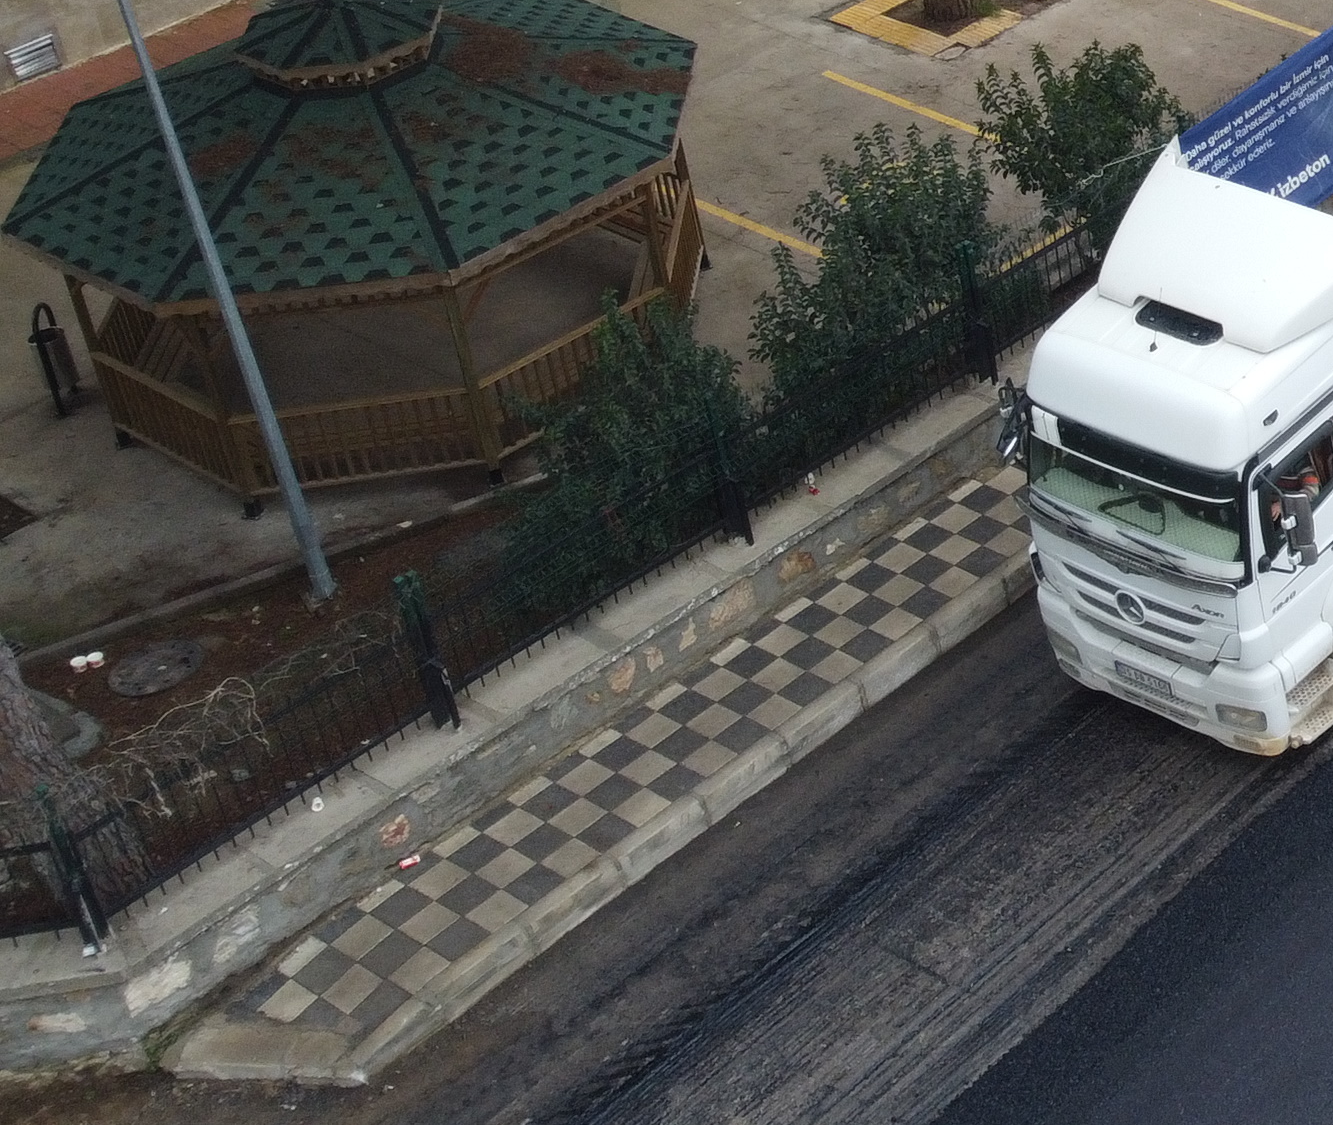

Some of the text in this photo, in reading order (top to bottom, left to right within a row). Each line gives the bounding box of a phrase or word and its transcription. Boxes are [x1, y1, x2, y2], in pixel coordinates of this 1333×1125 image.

[1186, 53, 1330, 162] Daha güzel ve konforlu bir İzmir için
[1285, 106, 1298, 119] ve
[1277, 152, 1331, 199] izbeton
